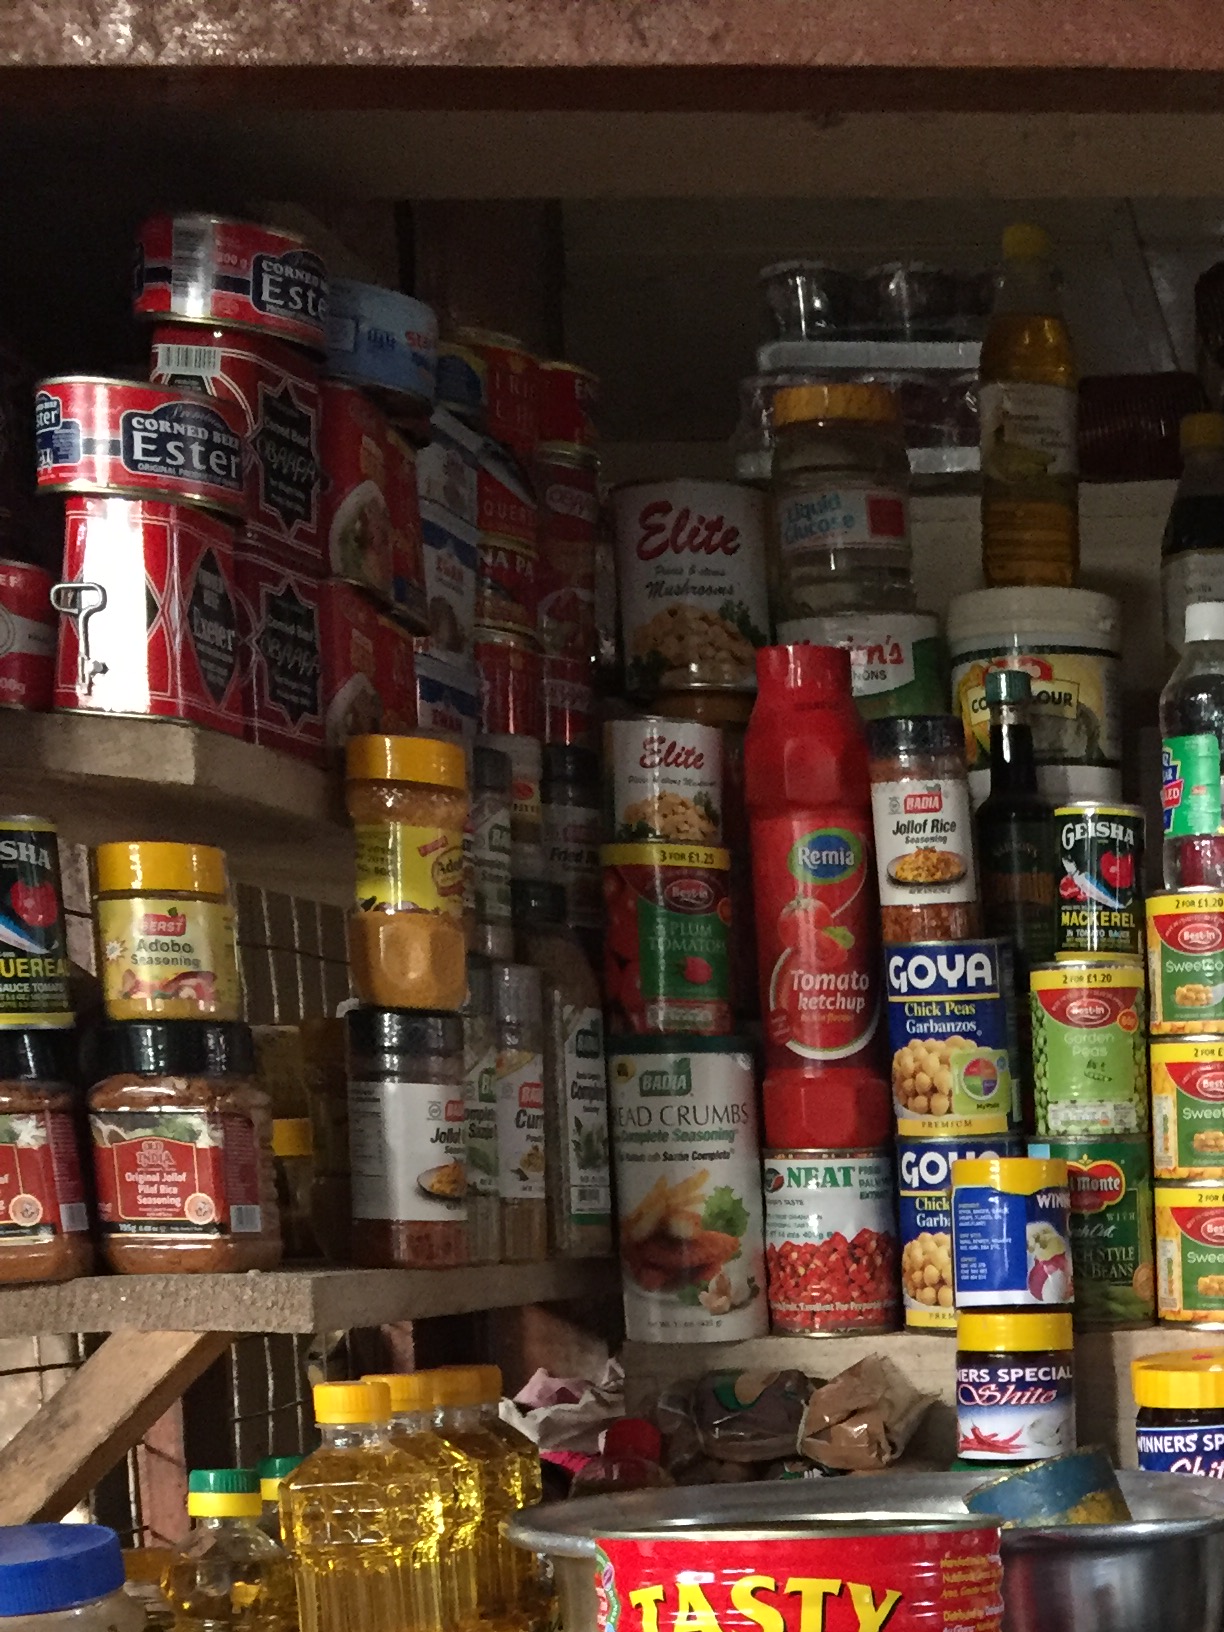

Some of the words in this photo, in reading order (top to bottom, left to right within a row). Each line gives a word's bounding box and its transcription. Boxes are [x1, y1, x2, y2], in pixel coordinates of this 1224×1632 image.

[131, 416, 208, 440] CORNED
[132, 430, 241, 480] Ester
[636, 500, 742, 562] Elite
[638, 734, 706, 771] Elite
[905, 794, 941, 811] BADIA
[892, 819, 928, 836] Jollof
[931, 819, 957, 834] Rice
[1061, 821, 1136, 851] GEISHA
[904, 835, 948, 846] Seasoning
[797, 846, 856, 869] Remia
[1174, 898, 1181, 909] 2
[1181, 899, 1196, 908] FOR
[1197, 897, 1224, 909] £1.20
[1060, 910, 1137, 929] MACKEREL
[1183, 930, 1217, 942] Best-in
[135, 939, 194, 955] Adobo
[130, 954, 202, 969] Seasoning
[790, 968, 870, 992] Tomato
[888, 952, 994, 994] GOYA
[1062, 974, 1069, 985] 2
[1086, 973, 1113, 985] £1.20
[797, 991, 866, 1013] ketchup
[904, 1001, 938, 1018] Chick
[944, 1001, 977, 1017] Peas
[905, 1018, 978, 1035] Garbanzos
[1193, 1047, 1200, 1058] 2
[1201, 1049, 1216, 1057] FOR
[641, 1074, 688, 1092] BADIA
[659, 1102, 750, 1127] CRUMBS
[920, 1118, 974, 1130] PREMIUM
[671, 1128, 736, 1144] Seasoning
[124, 1171, 161, 1185] Original
[161, 1171, 187, 1184] Jollof
[786, 1166, 855, 1189] NEAT
[1076, 1175, 1122, 1193] Monte
[159, 1184, 179, 1196] Rice
[1197, 1193, 1204, 1203] 2
[1205, 1194, 1220, 1202] FOR
[136, 1194, 182, 1209] Seasoning
[1099, 1246, 1136, 1262] STYLE
[1090, 1262, 1135, 1279] BEANS
[996, 1368, 1074, 1383] SPECIAL
[957, 1384, 1058, 1407] Shito
